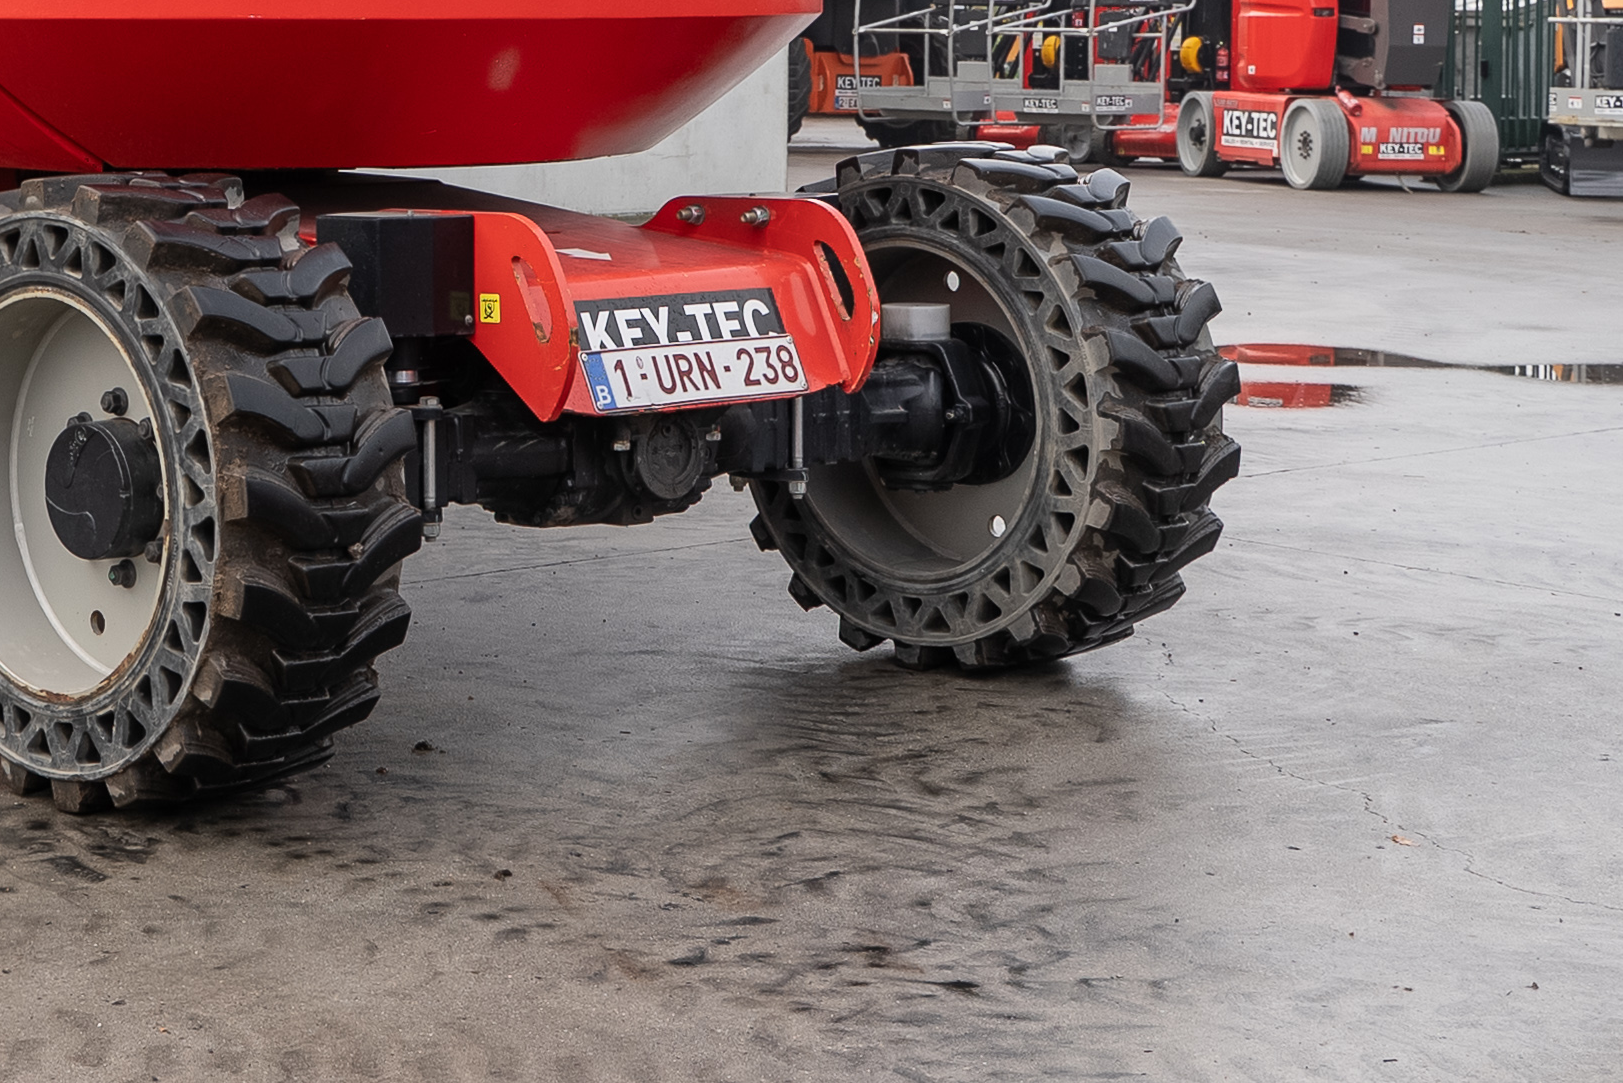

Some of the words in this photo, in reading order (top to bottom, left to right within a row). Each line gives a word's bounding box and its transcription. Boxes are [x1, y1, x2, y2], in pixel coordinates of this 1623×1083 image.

[1024, 99, 1057, 108] KEY-TEC
[1096, 96, 1125, 106] KEY-TEC
[1223, 110, 1277, 138] KEY-TEC
[1379, 143, 1423, 154] KEY-TEC
[579, 298, 779, 351] KEY-TEC
[596, 385, 612, 405] B
